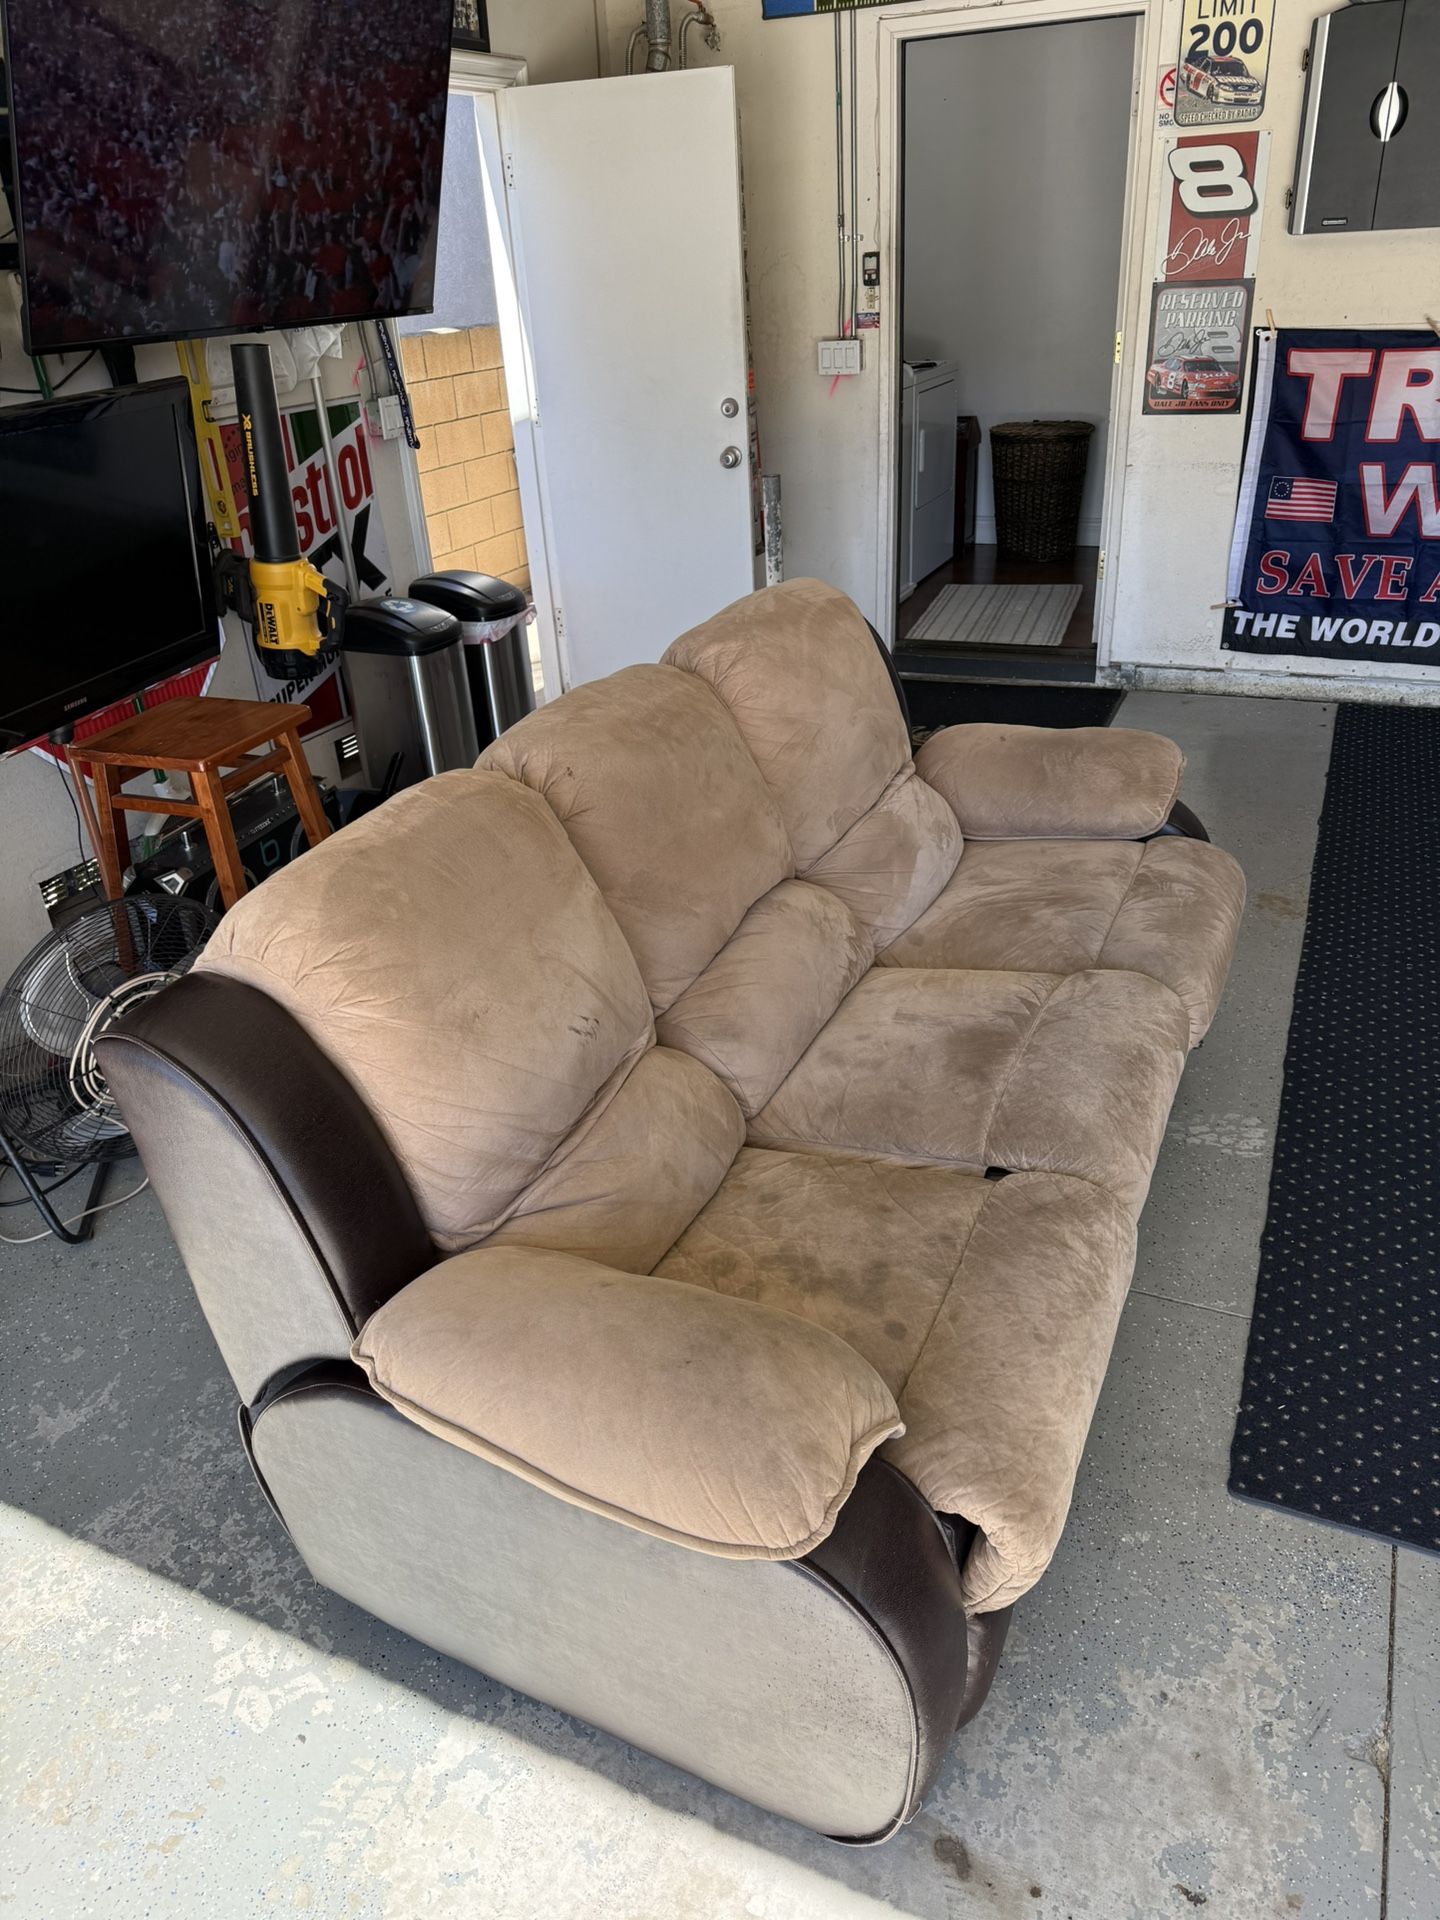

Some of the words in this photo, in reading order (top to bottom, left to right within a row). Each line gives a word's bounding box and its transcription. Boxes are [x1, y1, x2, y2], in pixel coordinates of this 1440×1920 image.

[1187, 18, 1264, 58] 200
[1159, 112, 1170, 120] NO
[1180, 112, 1199, 123] SPEED
[1200, 110, 1227, 121] CHECKED
[1227, 109, 1236, 119] BY
[1236, 108, 1257, 118] RADAR
[1168, 144, 1258, 217] 8
[1160, 291, 1244, 311] RESERVED
[1164, 310, 1236, 328] PARKING
[245, 431, 259, 497] BRUSHLESS
[1256, 550, 1414, 601] SAVE
[1233, 610, 1300, 639] THE
[1310, 615, 1440, 649] WORLD
